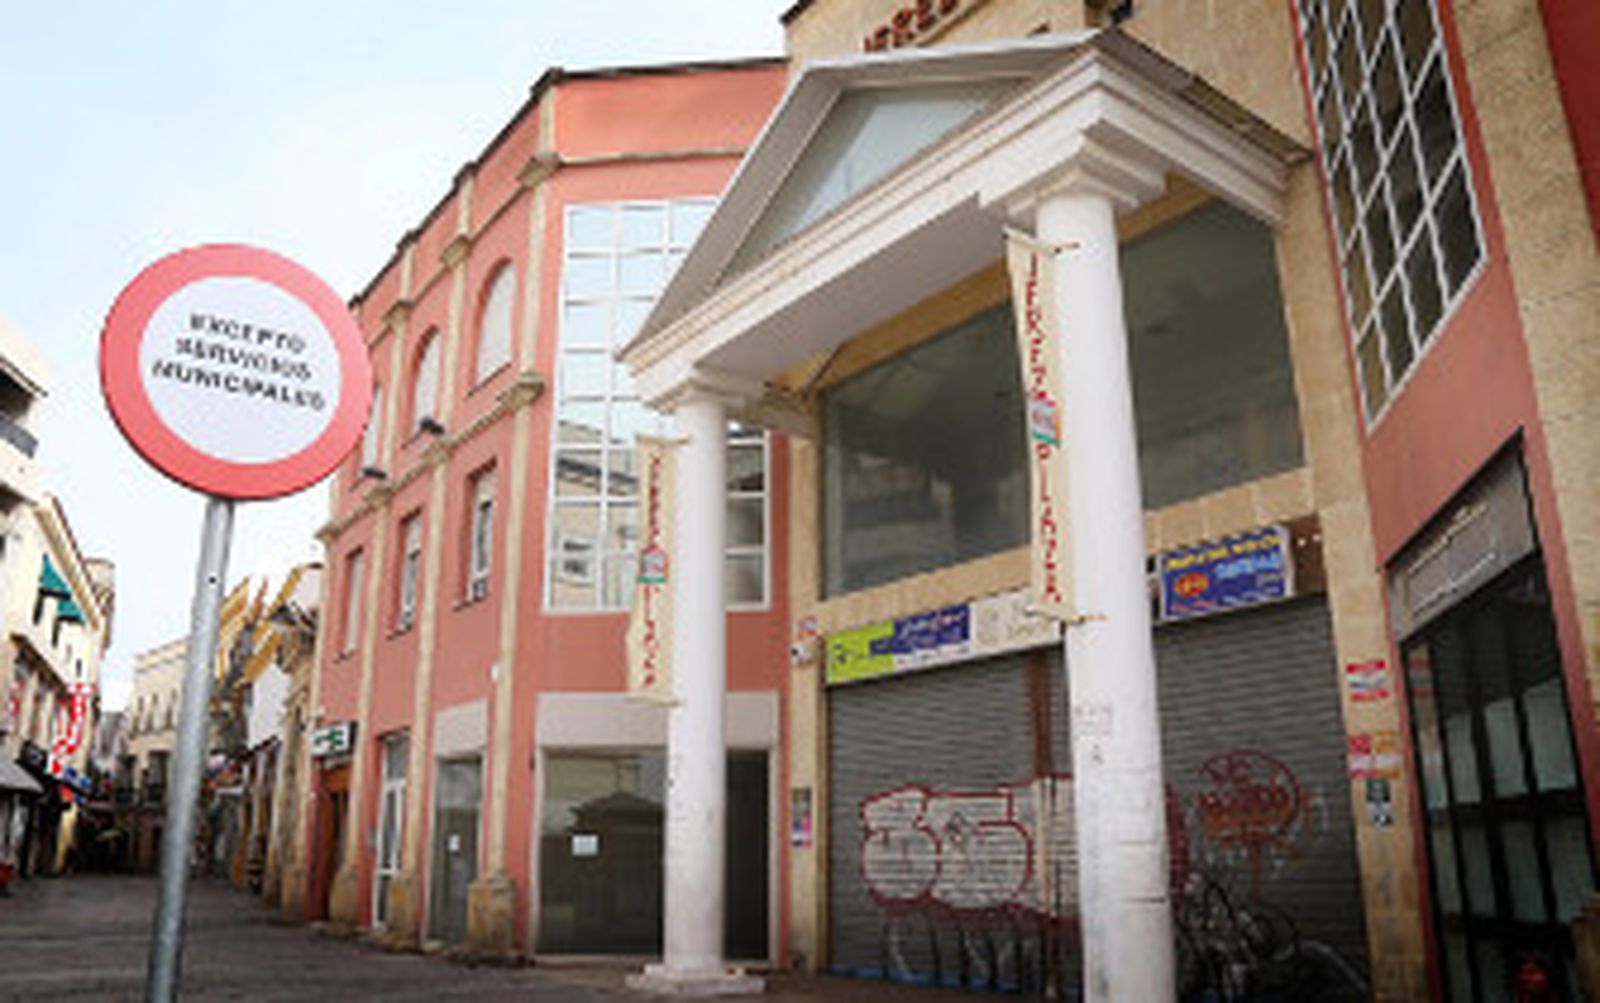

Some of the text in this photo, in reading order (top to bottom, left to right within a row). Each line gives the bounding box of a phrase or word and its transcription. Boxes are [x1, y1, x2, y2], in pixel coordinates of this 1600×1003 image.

[190, 314, 306, 354] EXCEPTO
[176, 337, 311, 382] SERVICIOS
[152, 359, 325, 411] MUNICIPALES
